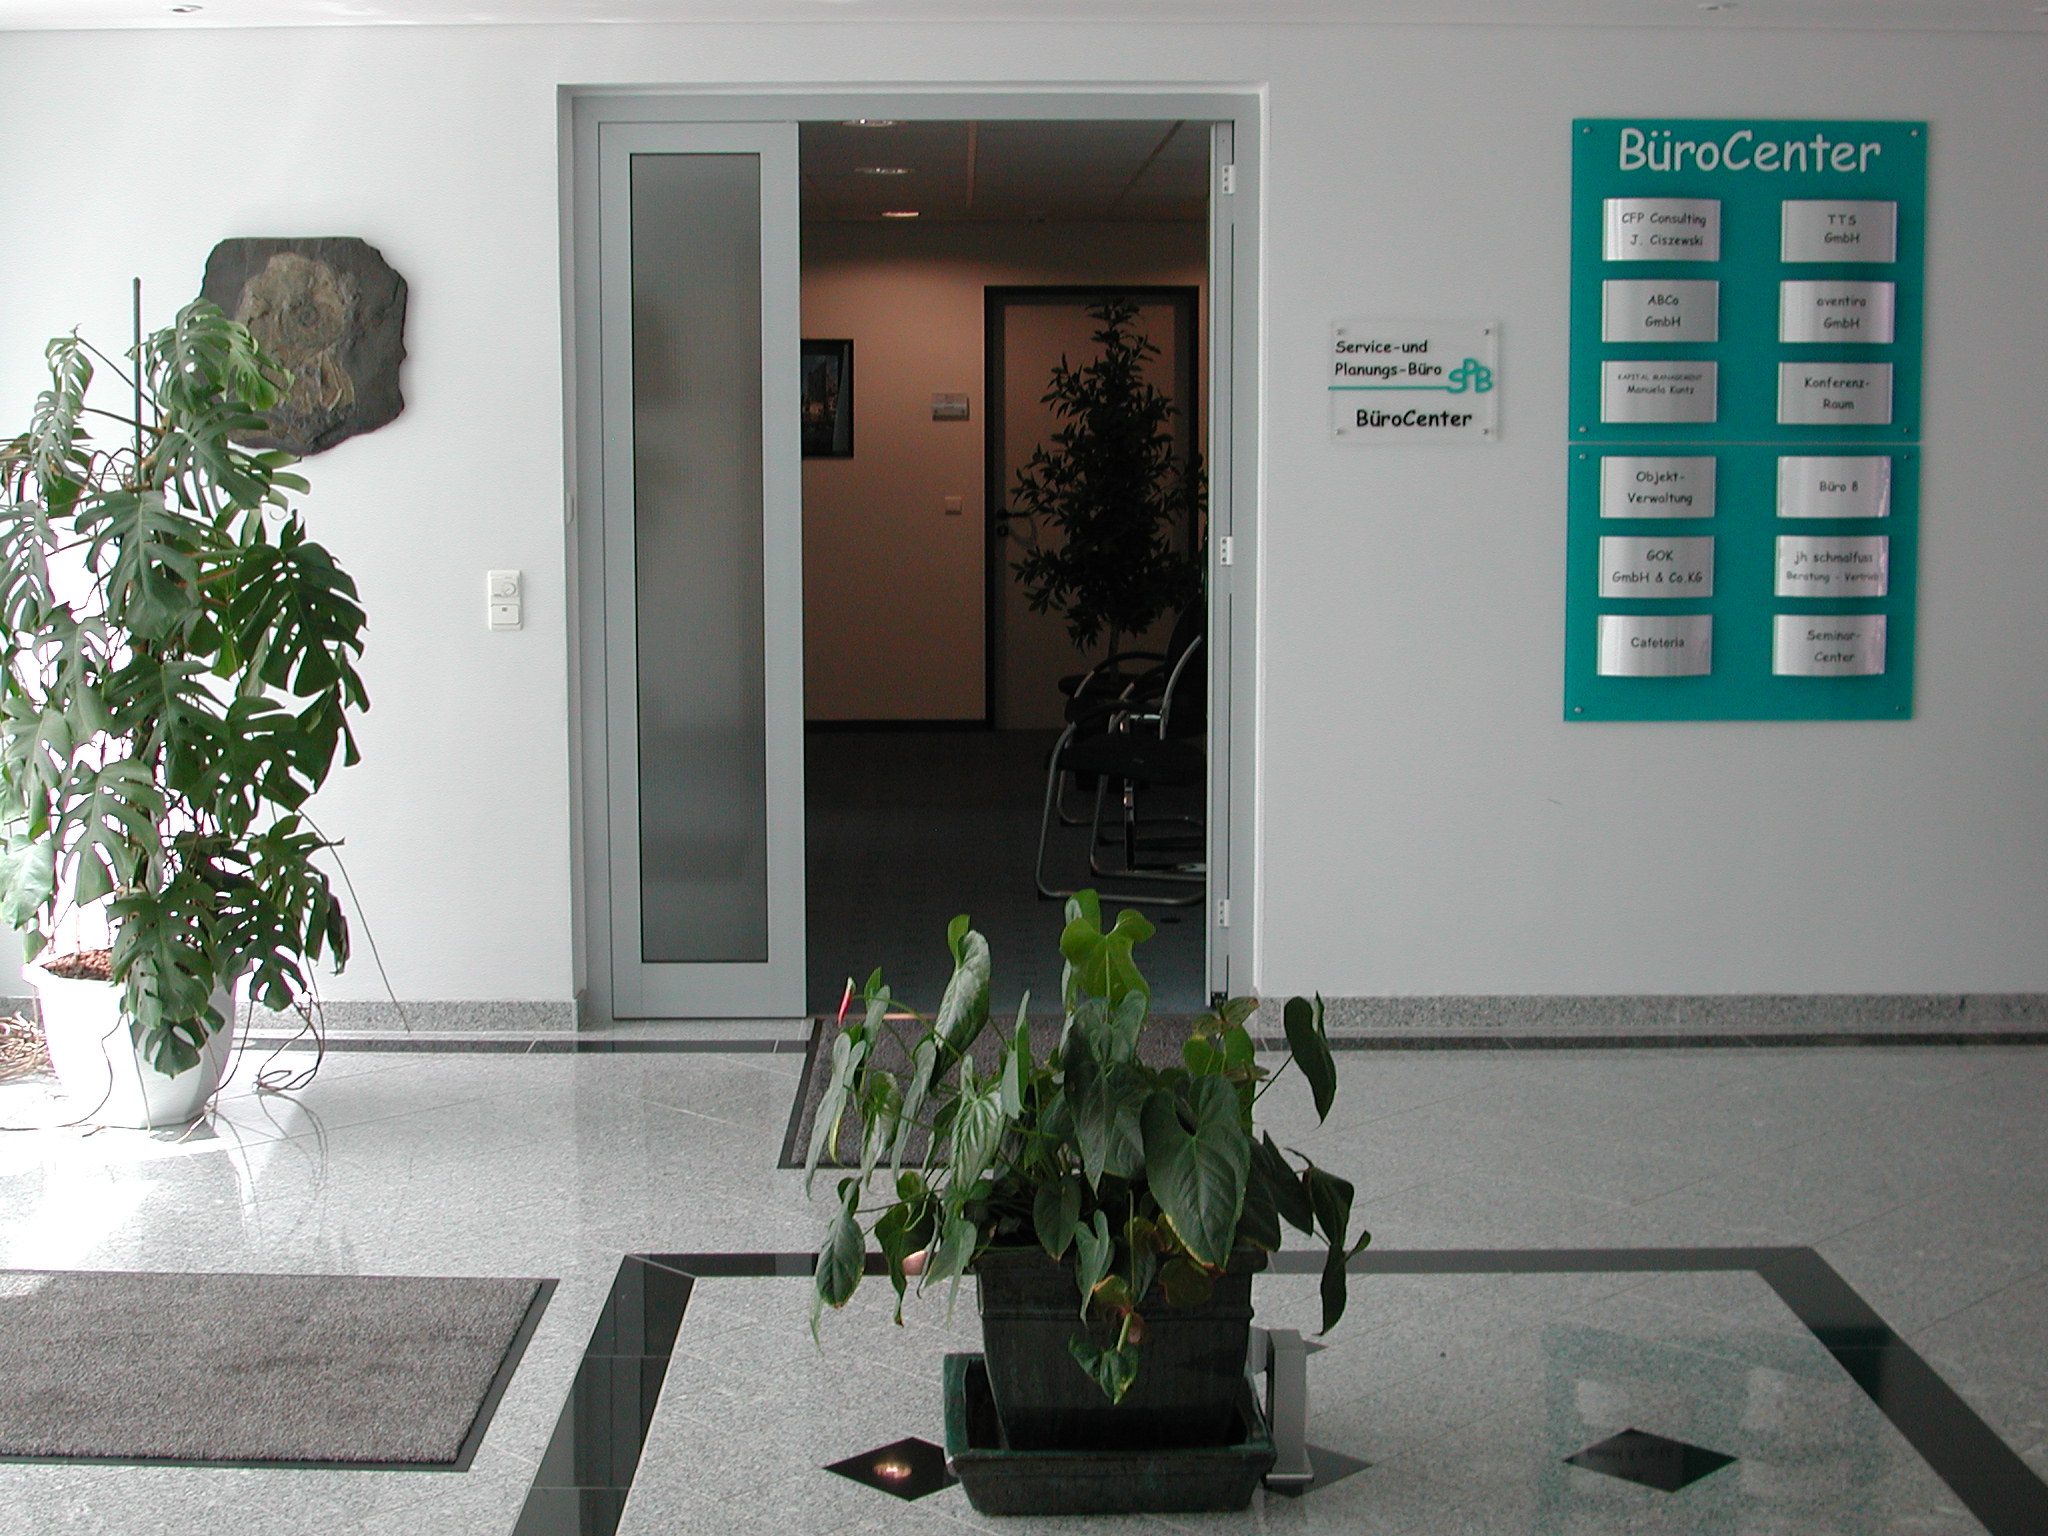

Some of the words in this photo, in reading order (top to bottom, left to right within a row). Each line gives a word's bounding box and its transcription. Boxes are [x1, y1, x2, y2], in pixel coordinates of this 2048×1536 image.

[1619, 127, 1881, 173] BüroCenter
[1621, 212, 1645, 224] CFP
[1649, 211, 1707, 228] Consulting
[1827, 214, 1858, 227] TTS
[1630, 234, 1643, 246] J.
[1650, 234, 1704, 246] Ciszewski
[1824, 232, 1861, 245] GmbH
[1647, 295, 1680, 306] ABCo
[1645, 316, 1681, 328] GmbH
[1823, 316, 1861, 329] GmbH
[1334, 361, 1443, 380] Planungs-Büro
[1626, 384, 1666, 395] Manuela
[1804, 377, 1871, 389] Konferenz-
[1822, 398, 1855, 410] Raum
[1356, 408, 1473, 428] BüroCenter
[1636, 471, 1685, 486] Objekt-
[1819, 481, 1846, 493] Büro
[1627, 493, 1693, 506] Verwaltung
[1646, 549, 1674, 561] GOK
[1612, 571, 1650, 583] GmbH
[1655, 572, 1664, 583] &
[1786, 571, 1831, 584] Beratung
[1807, 629, 1861, 642] Seminar-
[1630, 636, 1685, 649] Cafeteria
[1814, 651, 1856, 664] Center
